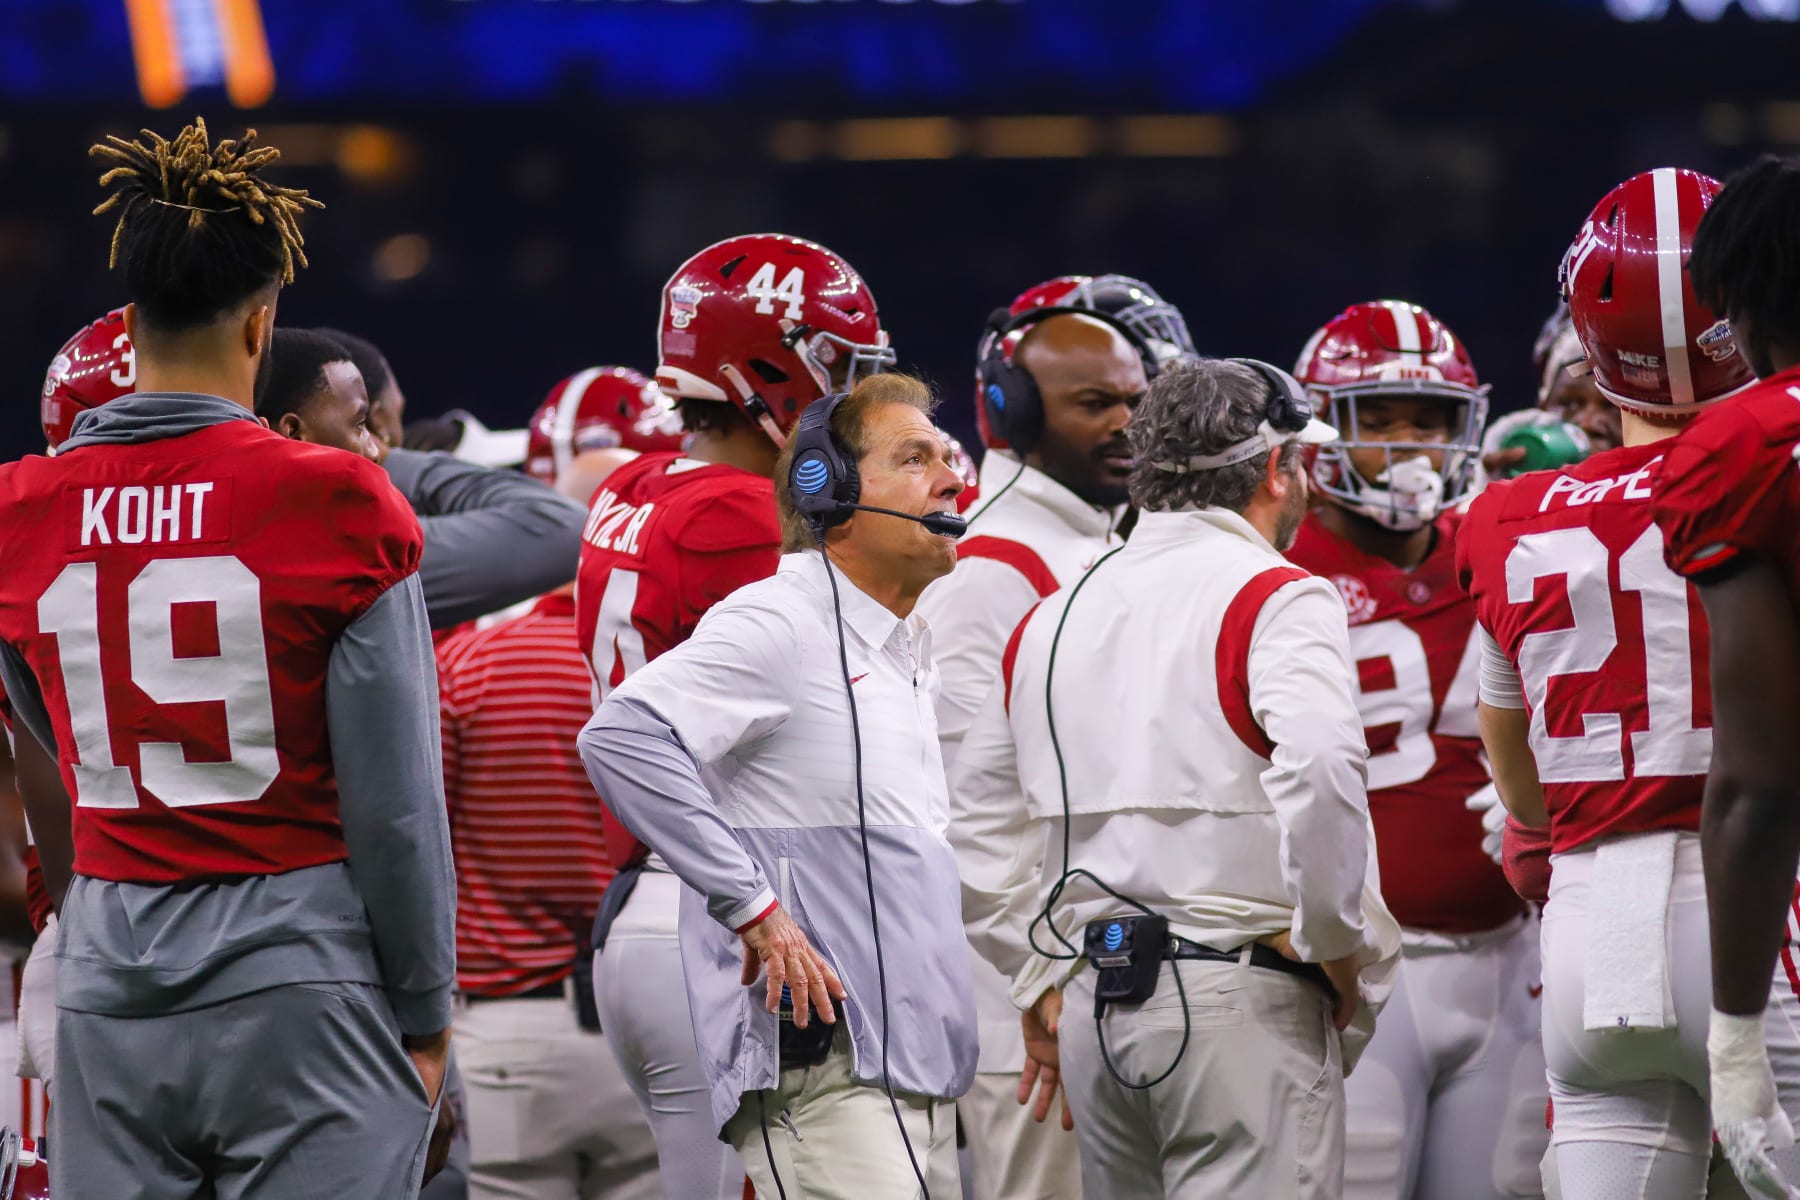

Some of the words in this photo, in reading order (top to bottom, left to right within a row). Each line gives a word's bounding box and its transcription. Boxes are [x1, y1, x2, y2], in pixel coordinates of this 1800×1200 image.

[746, 262, 805, 321] 44
[110, 333, 137, 387] 3
[80, 482, 214, 546] KOHT
[37, 555, 281, 809] 19
[1505, 522, 1713, 783] 21
